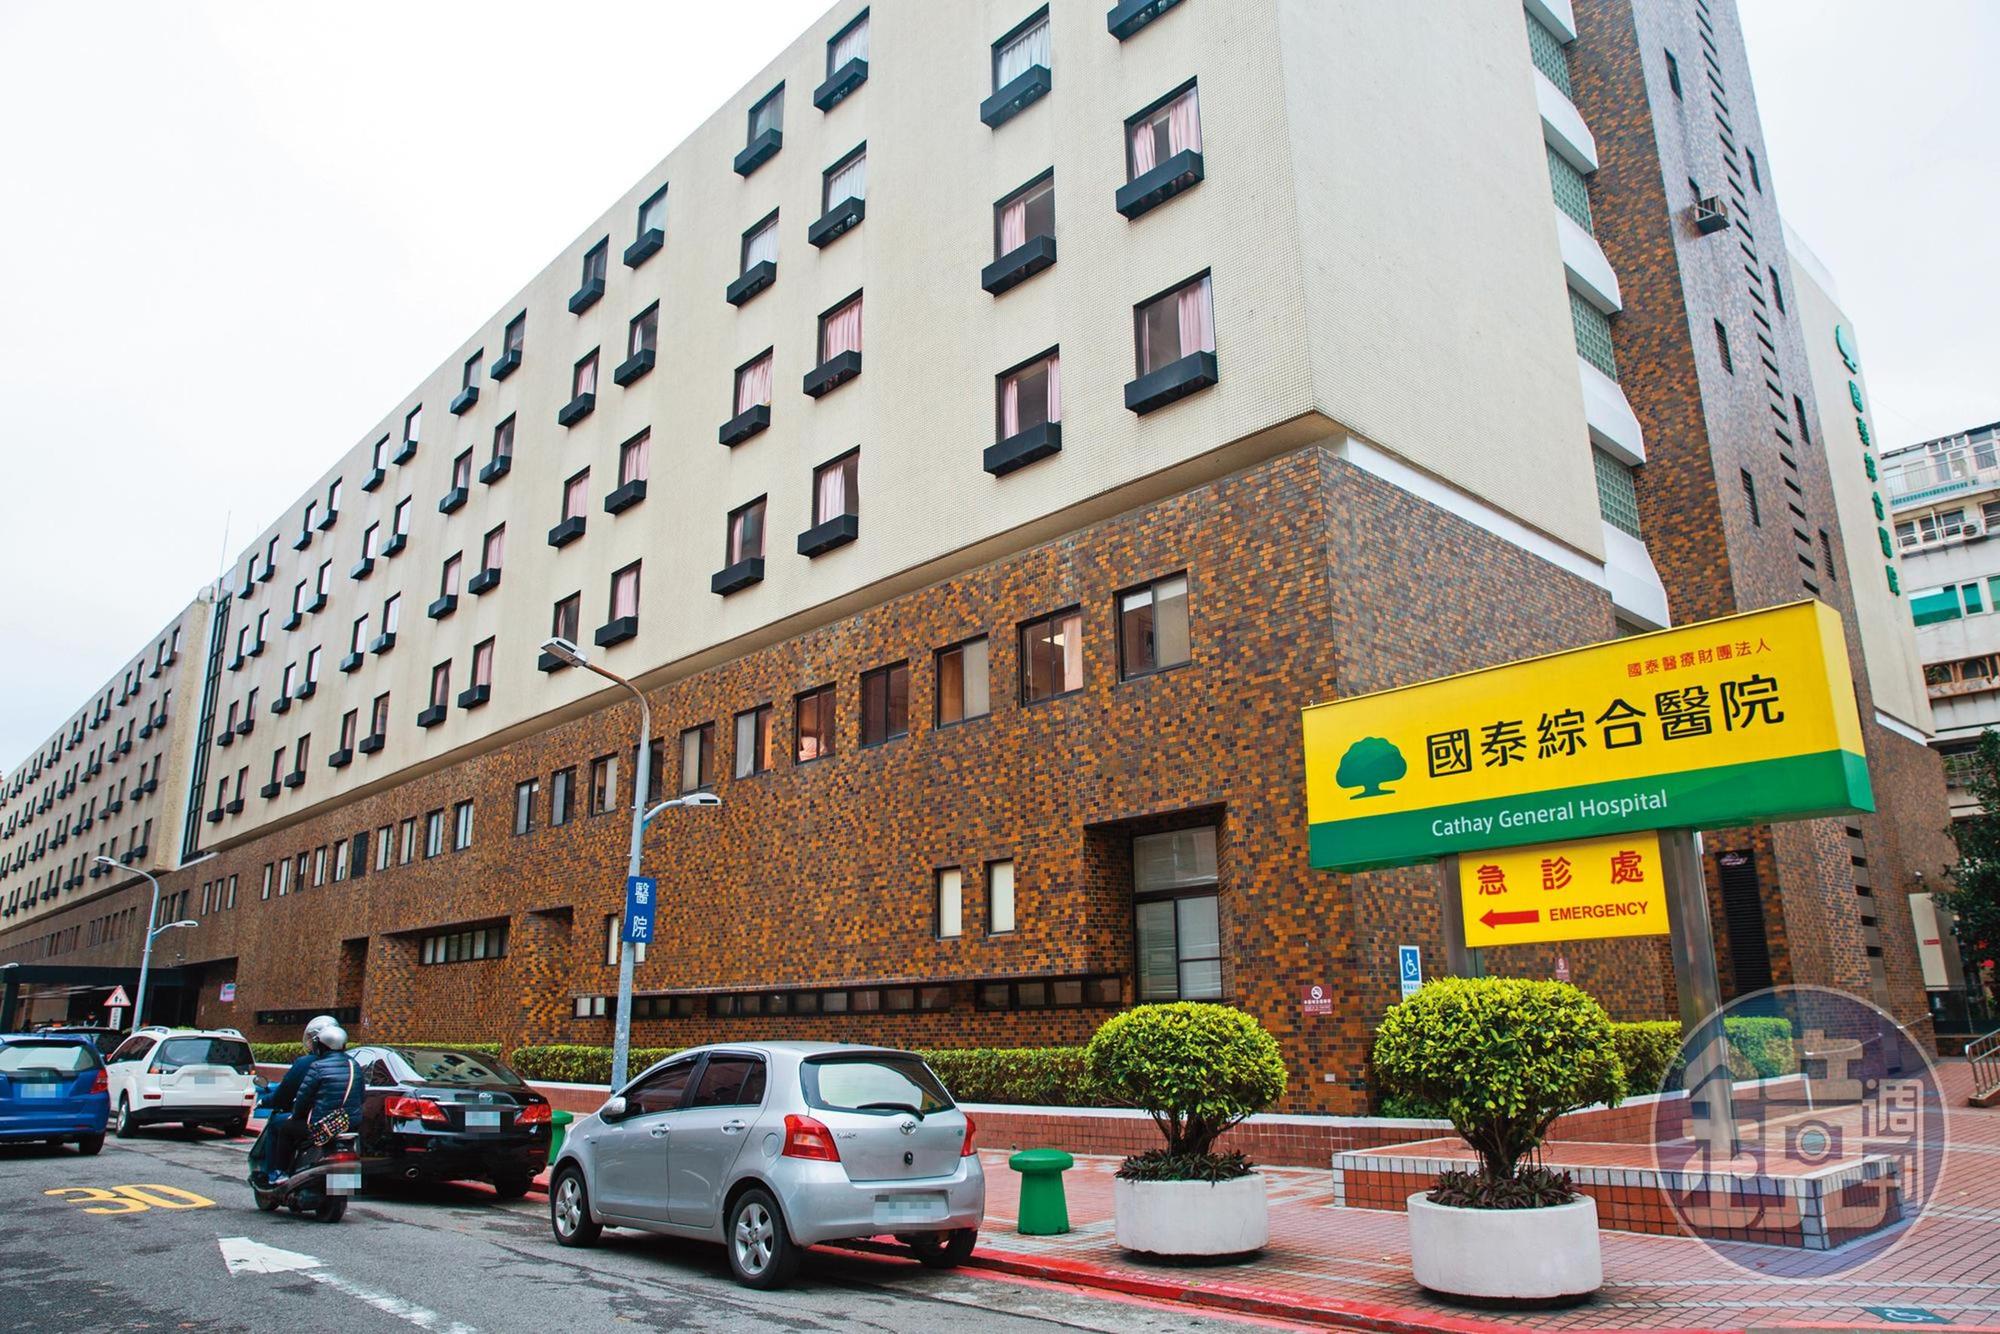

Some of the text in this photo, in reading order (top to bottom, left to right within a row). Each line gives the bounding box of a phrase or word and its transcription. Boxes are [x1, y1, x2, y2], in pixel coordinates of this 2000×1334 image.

[1627, 638, 1772, 678] 國泰醫療財團法人
[1426, 674, 1784, 778] 國泰綜合醫院
[1432, 789, 1668, 837] Cathay General Hospital
[1477, 851, 1644, 896] 急診處
[631, 881, 650, 938] 醫院
[1550, 901, 1649, 922] EMERGENCY
[43, 1184, 217, 1215] 30
